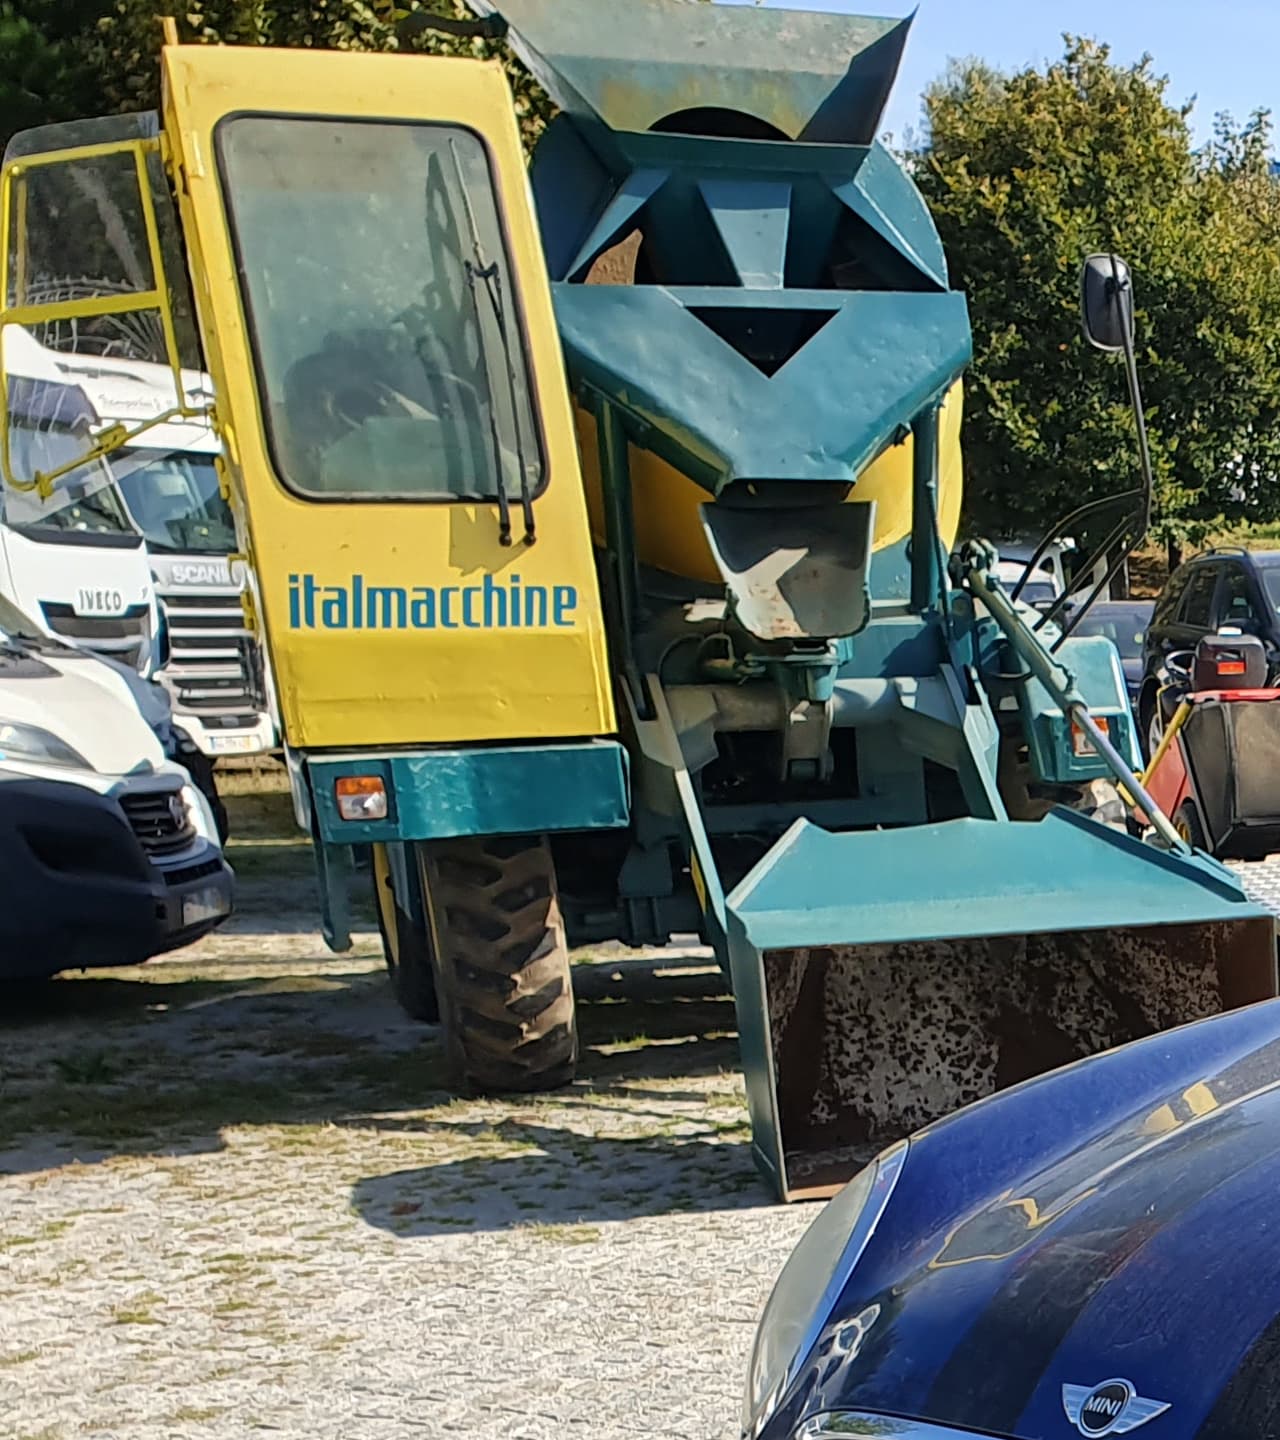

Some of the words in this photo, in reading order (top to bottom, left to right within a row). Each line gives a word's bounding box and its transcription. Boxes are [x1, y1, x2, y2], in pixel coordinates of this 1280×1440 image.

[79, 589, 122, 611] IVECO
[289, 574, 577, 628] italmacchine
[1084, 1396, 1122, 1417] MINI
